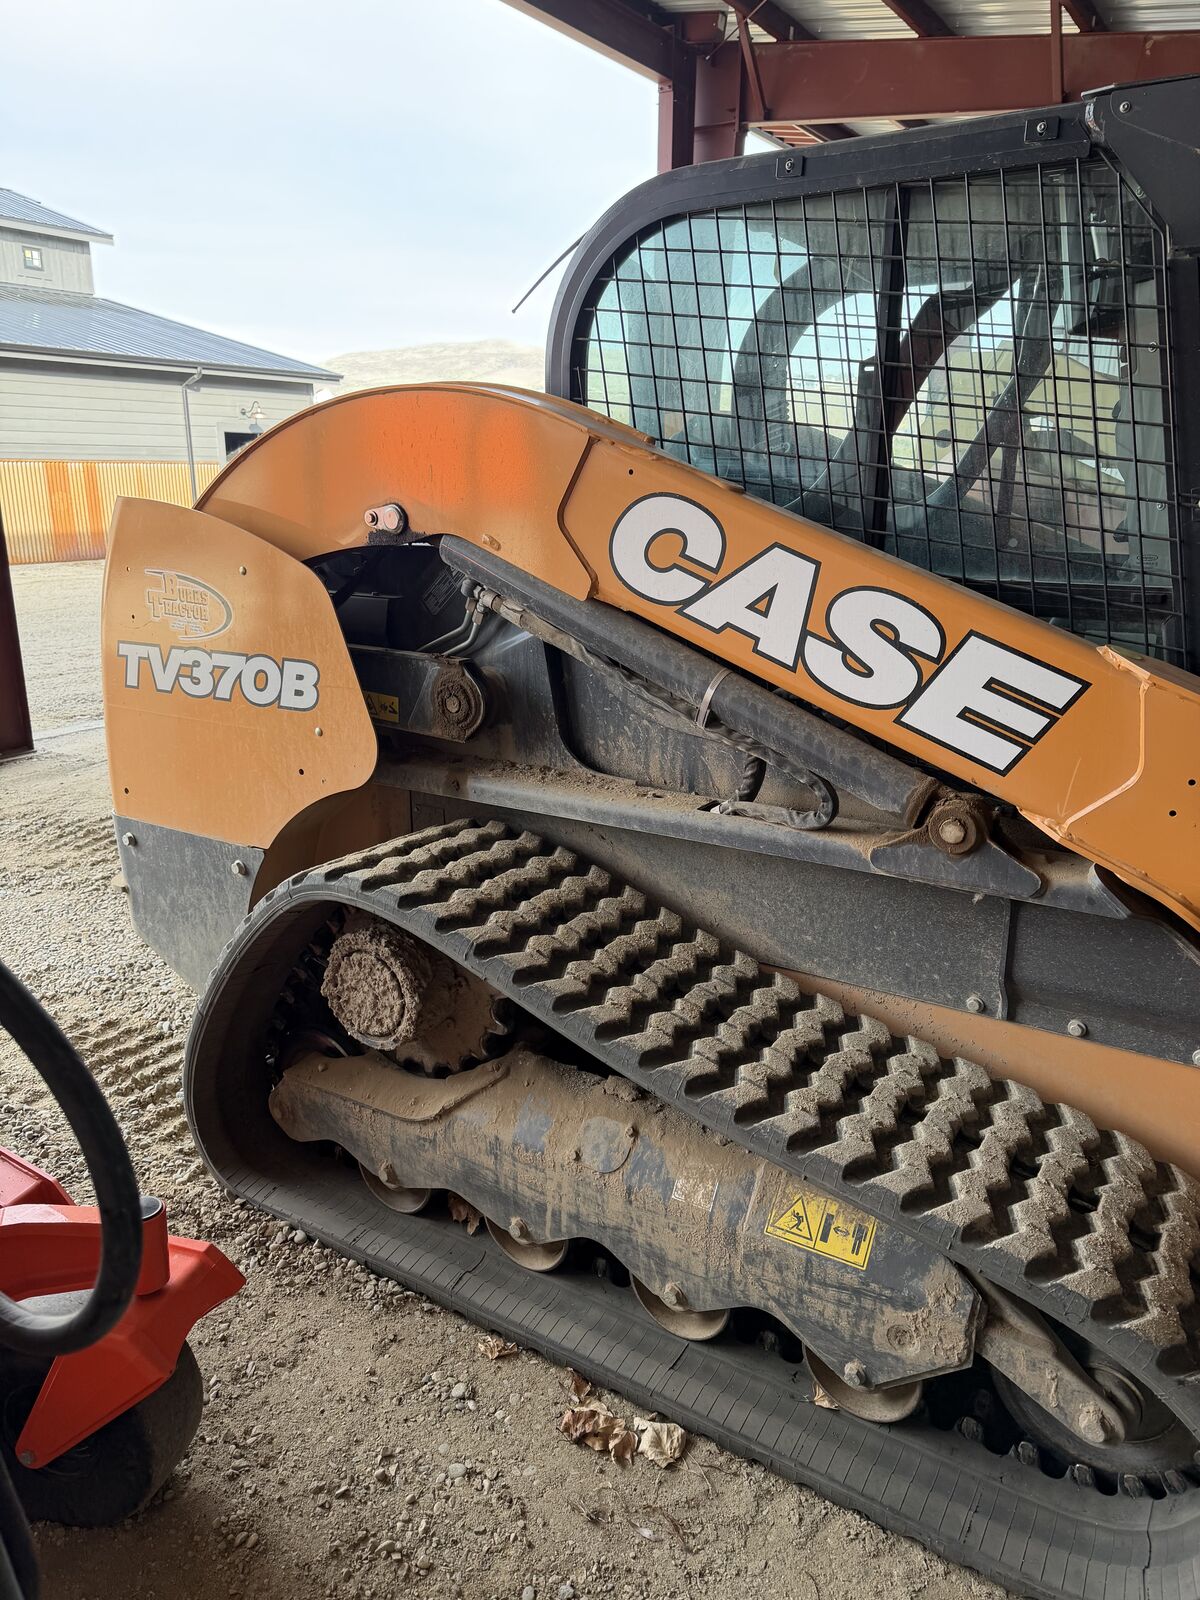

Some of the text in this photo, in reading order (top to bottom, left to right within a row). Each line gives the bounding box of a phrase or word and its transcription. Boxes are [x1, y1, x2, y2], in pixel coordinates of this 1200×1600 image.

[147, 590, 209, 621] TRACTOR
[609, 492, 1092, 776] CASE
[118, 641, 319, 711] TV370B
